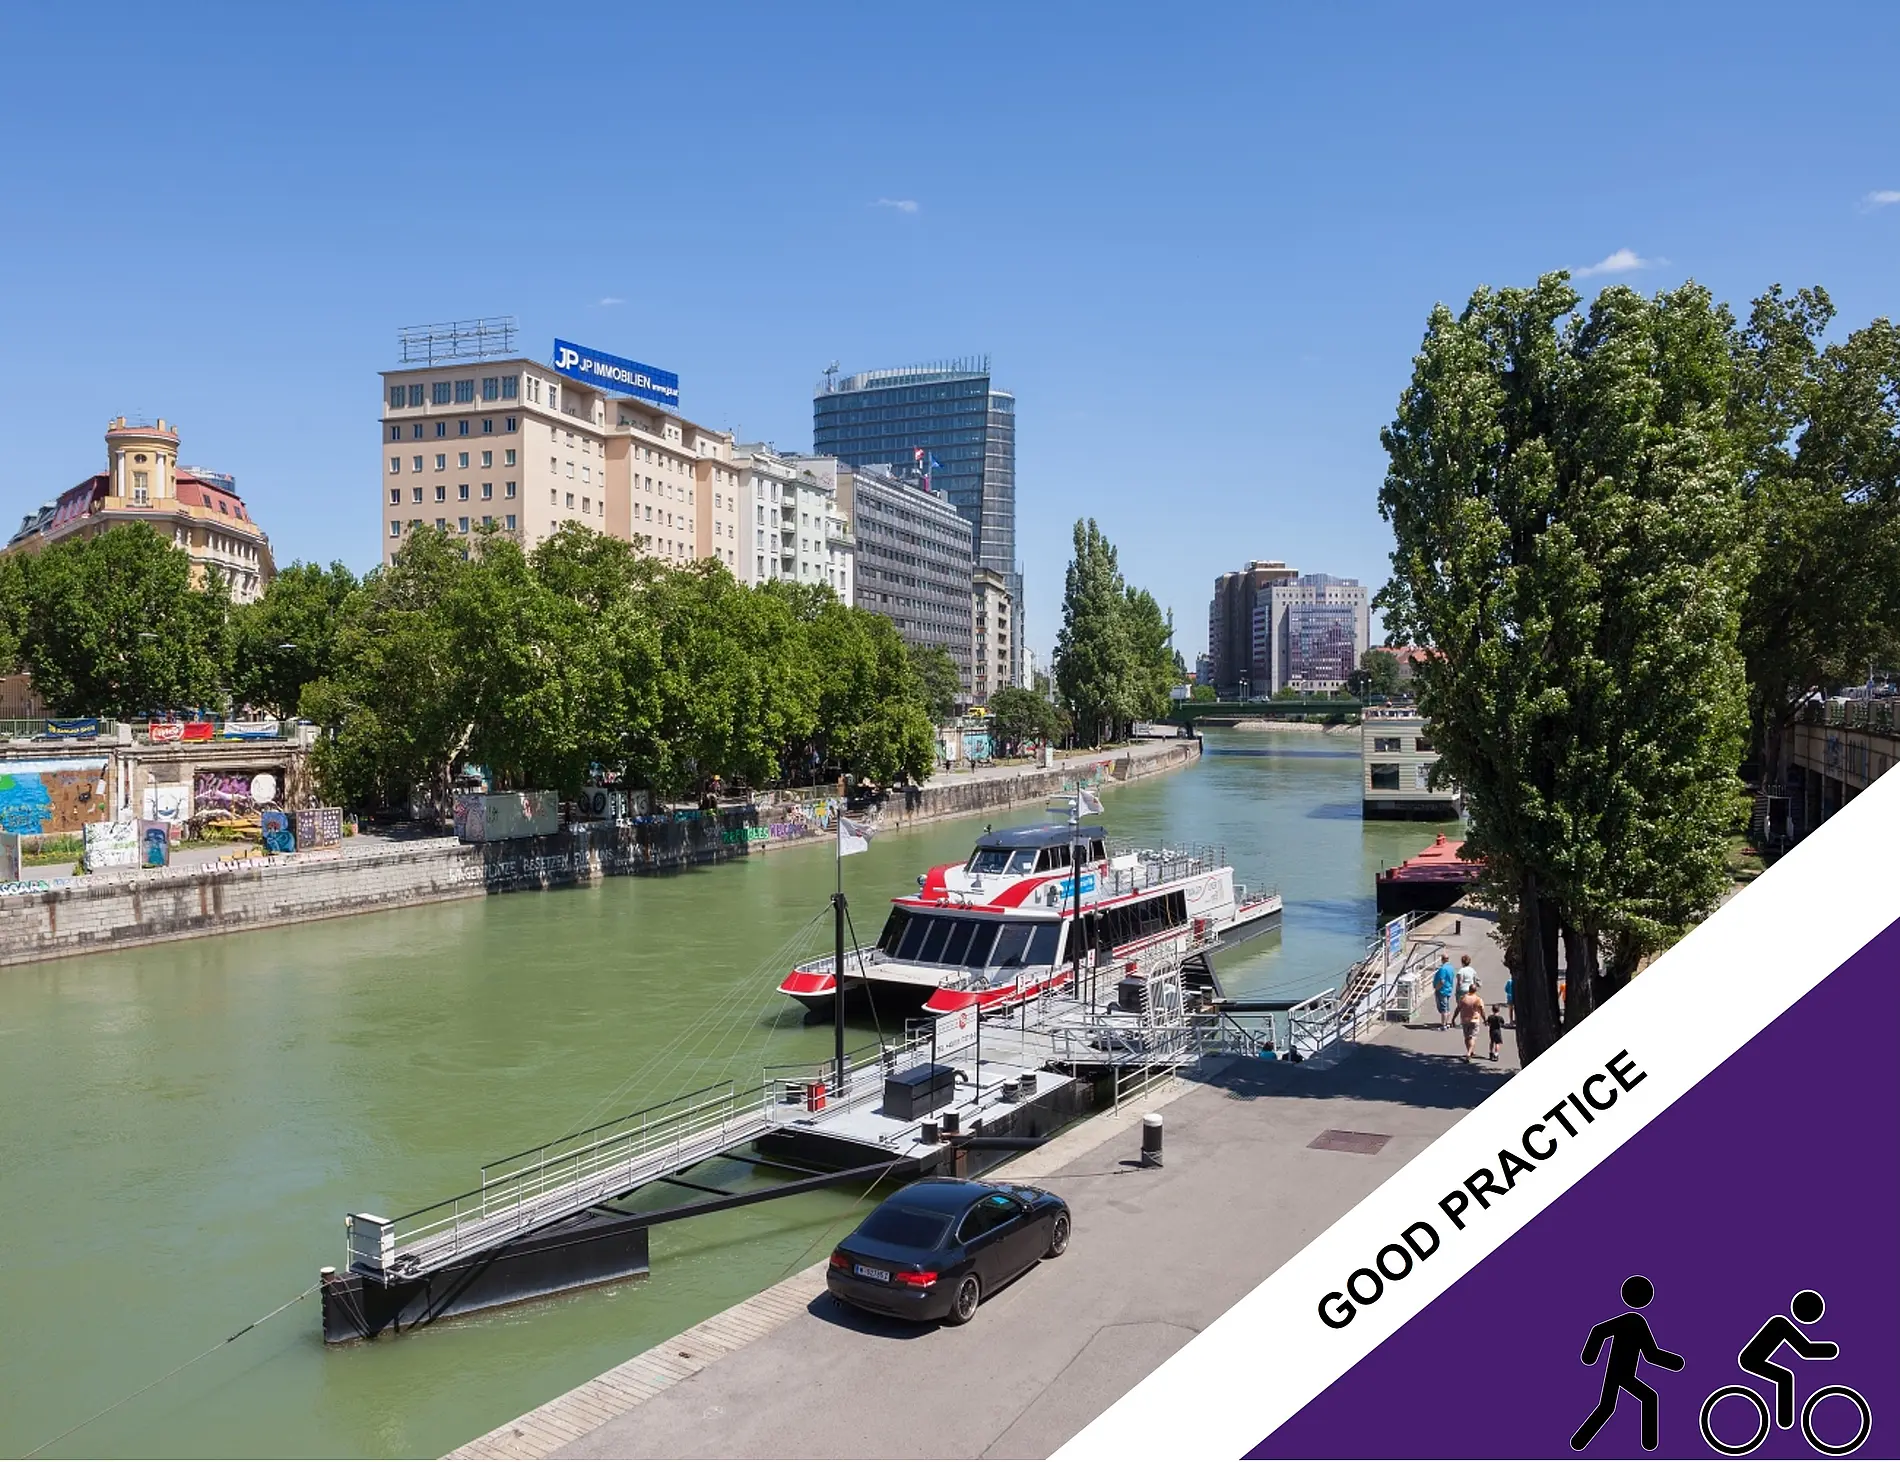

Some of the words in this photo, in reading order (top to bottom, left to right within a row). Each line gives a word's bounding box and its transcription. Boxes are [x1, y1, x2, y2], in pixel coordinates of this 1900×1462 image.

[555, 346, 579, 370] JP
[579, 358, 593, 373] JP
[593, 361, 651, 389] IMMOBILIEN
[722, 824, 768, 844] REFUGEES
[523, 852, 569, 872] BESETZEN
